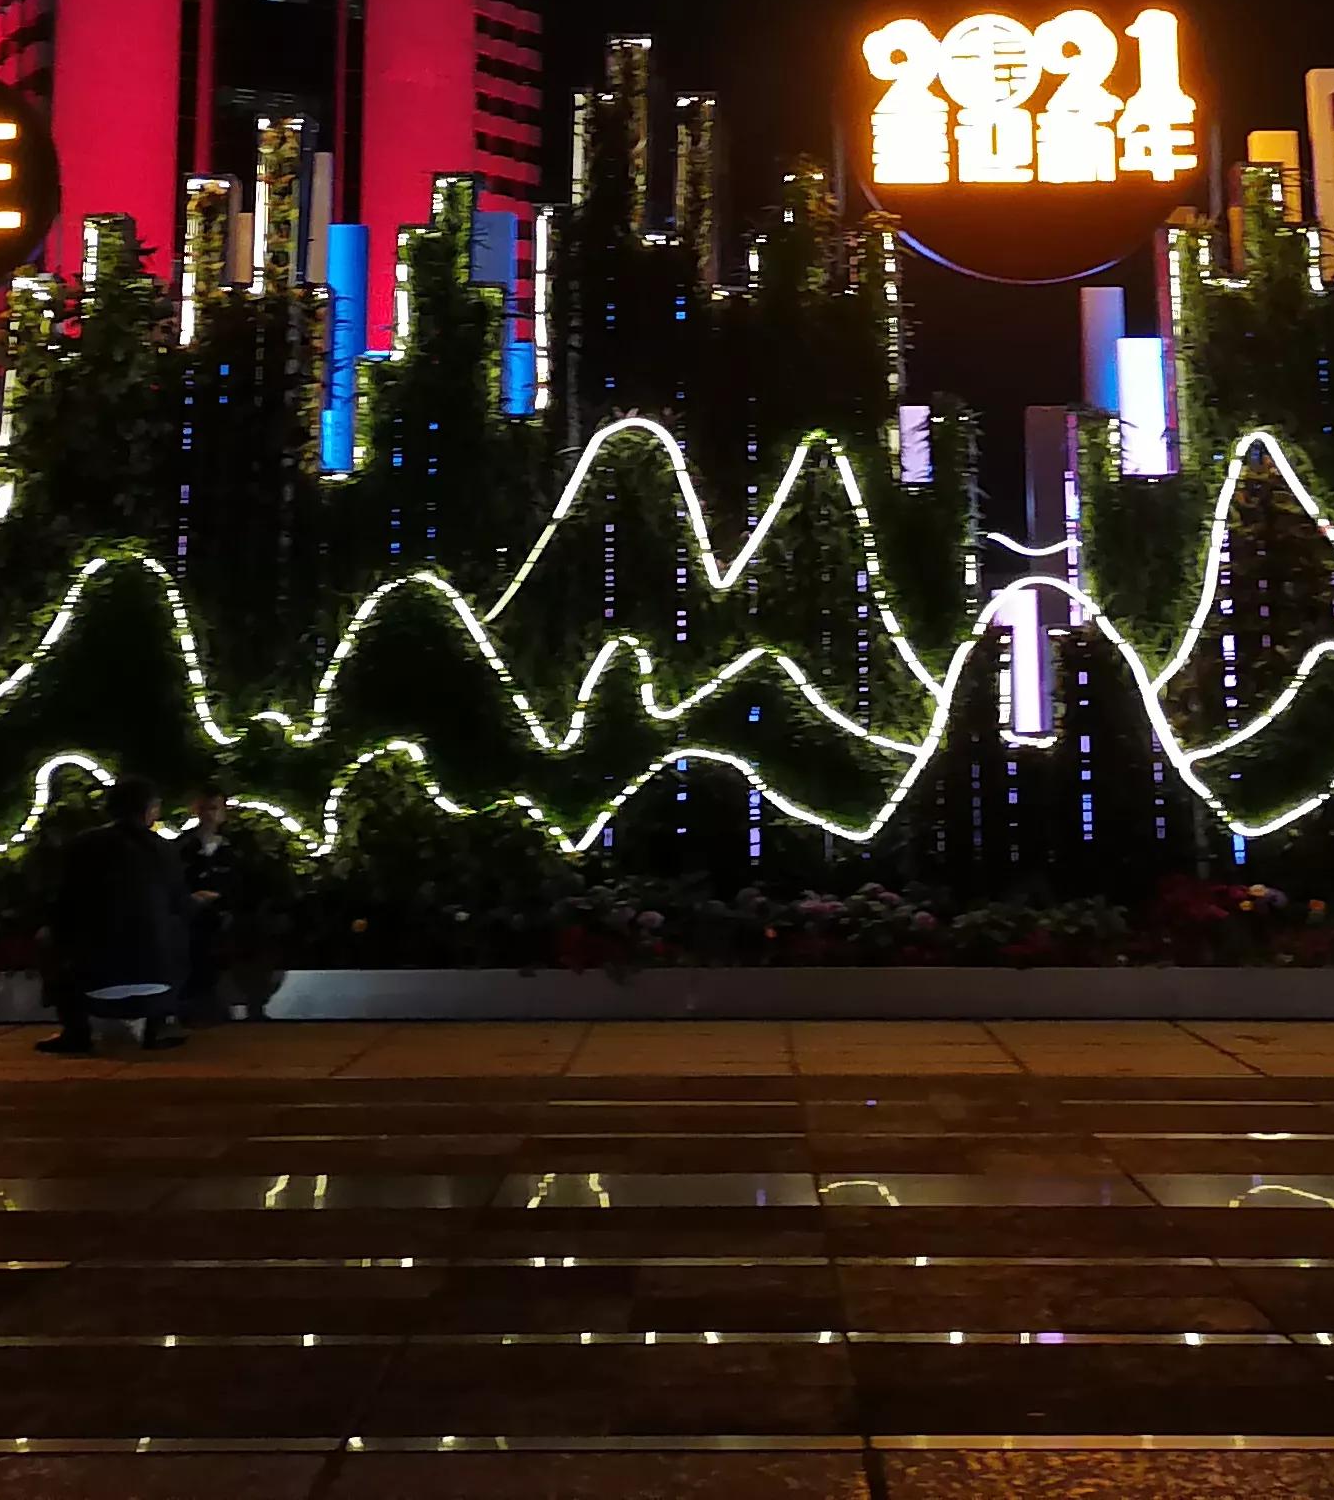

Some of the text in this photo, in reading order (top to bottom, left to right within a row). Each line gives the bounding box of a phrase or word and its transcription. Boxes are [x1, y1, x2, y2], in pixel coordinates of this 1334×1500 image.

[862, 8, 1180, 111] 2021
[869, 102, 1199, 184] 喜迎新年
